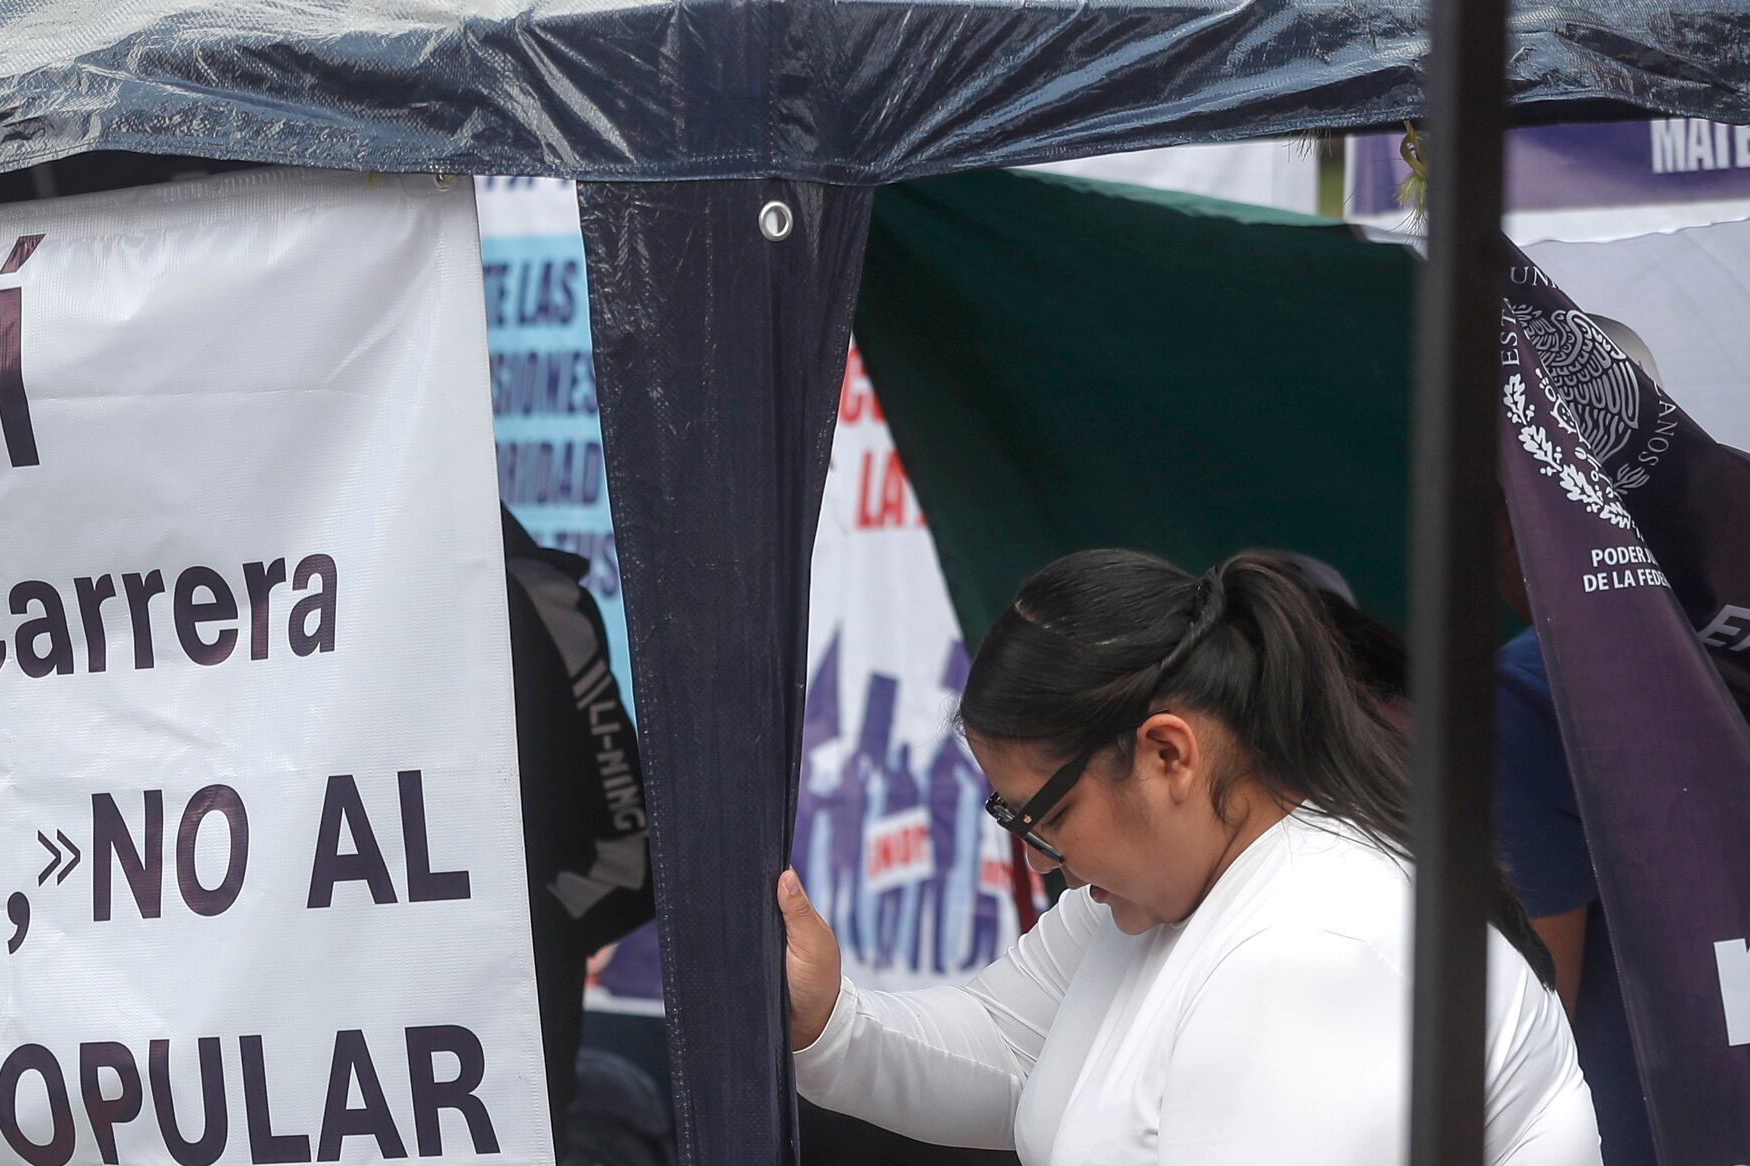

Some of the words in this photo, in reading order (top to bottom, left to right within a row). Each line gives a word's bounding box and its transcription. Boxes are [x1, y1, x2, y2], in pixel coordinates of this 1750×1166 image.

[1591, 546, 1646, 567] PODER
[1583, 573, 1609, 592] DE
[1612, 570, 1636, 588] LA
[307, 770, 471, 908] AL
